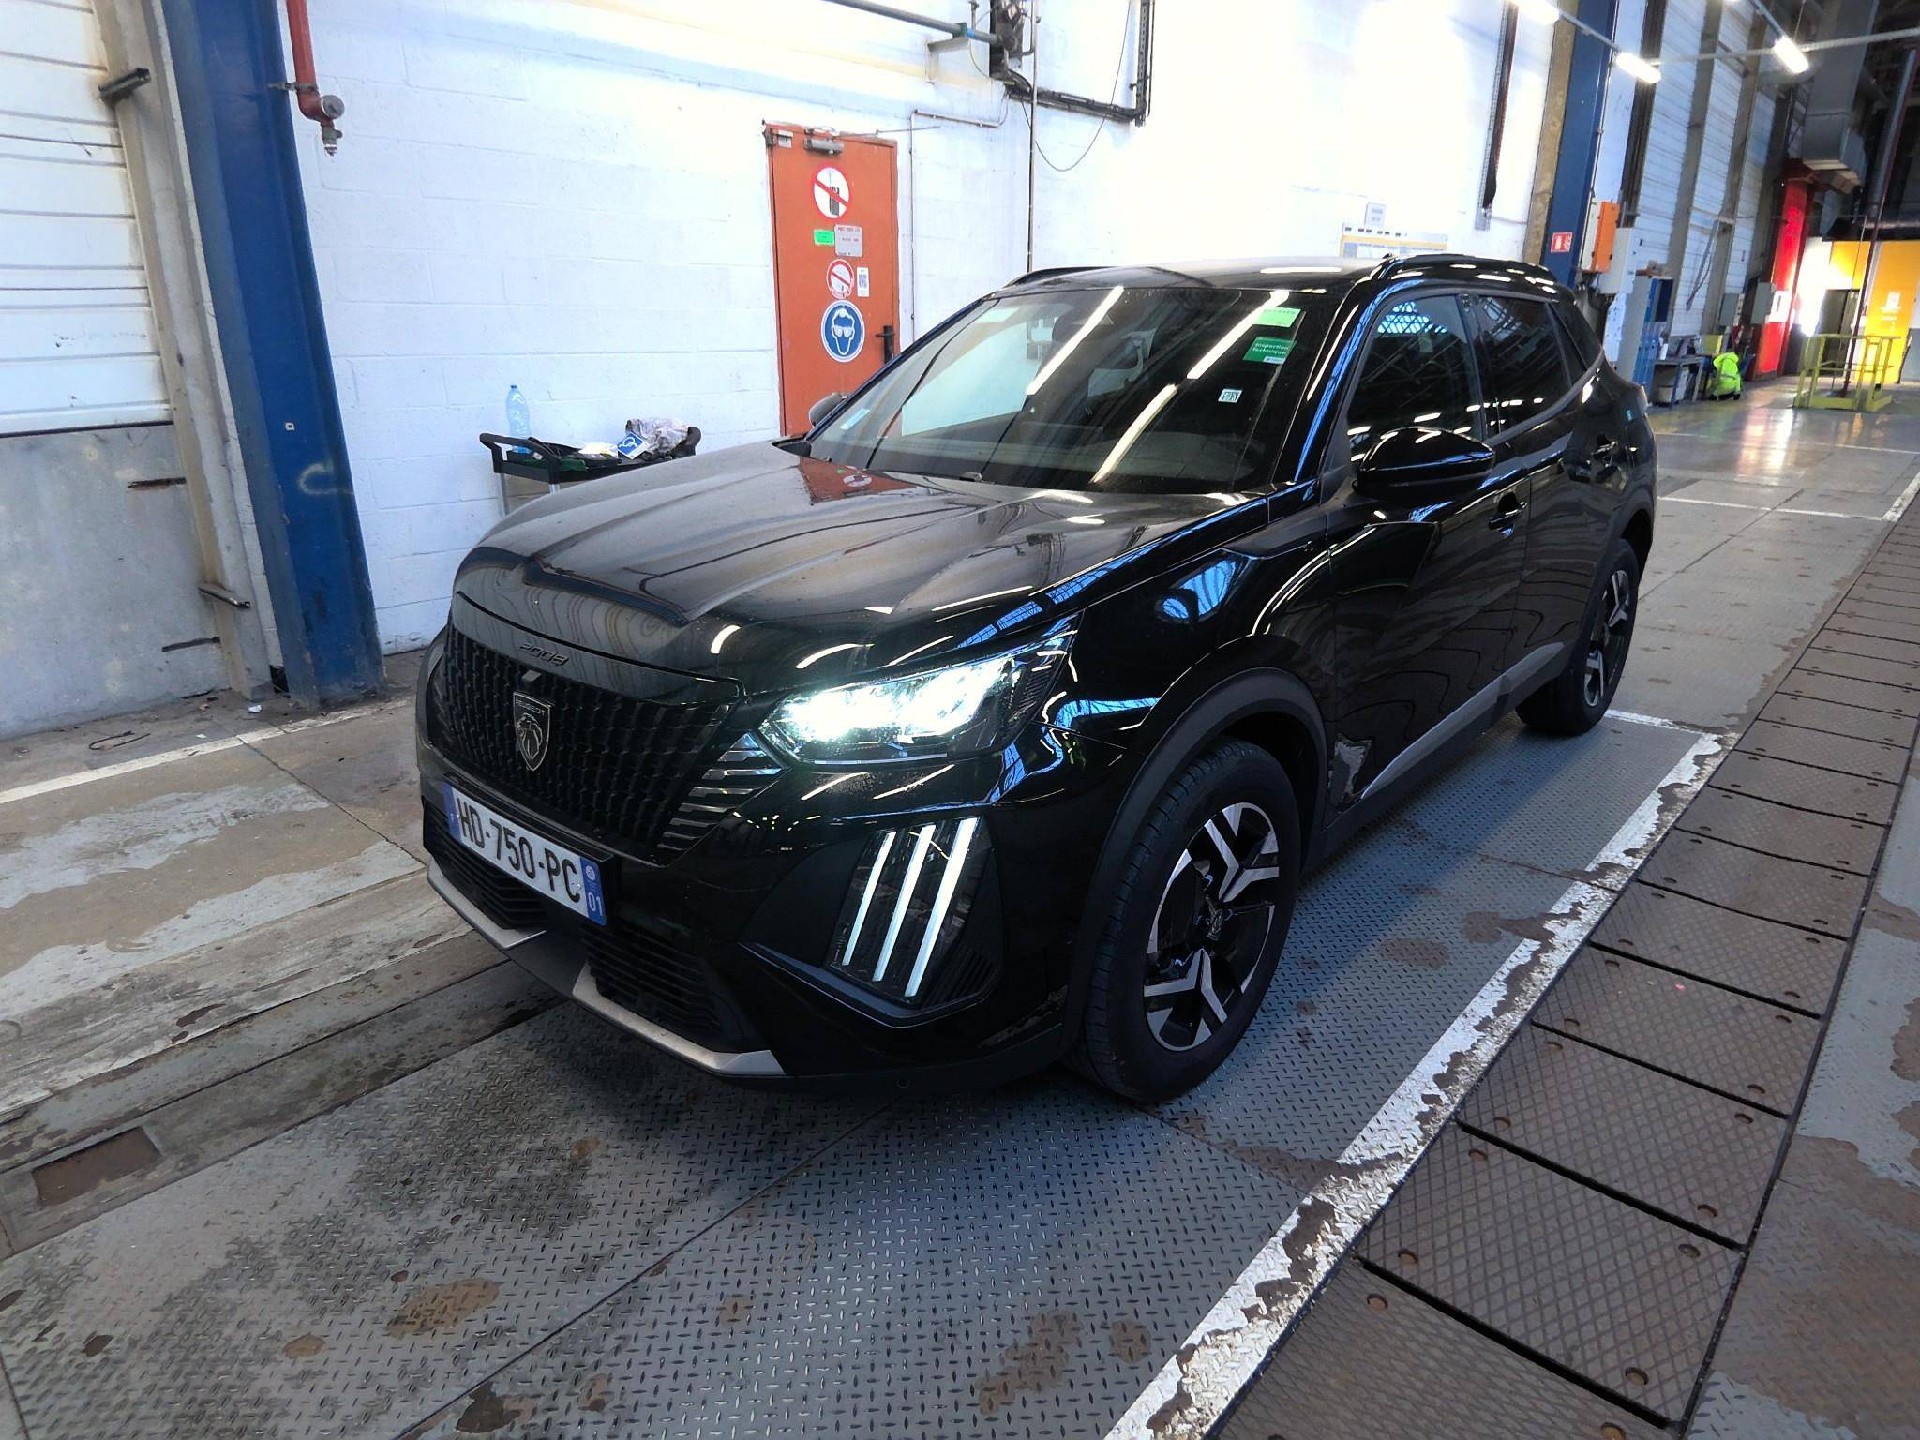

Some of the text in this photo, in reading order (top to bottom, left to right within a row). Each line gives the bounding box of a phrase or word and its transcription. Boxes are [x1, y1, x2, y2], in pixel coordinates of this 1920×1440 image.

[519, 642, 569, 666] 2008
[457, 797, 581, 904] HD-750-PC
[586, 892, 604, 916] 01
